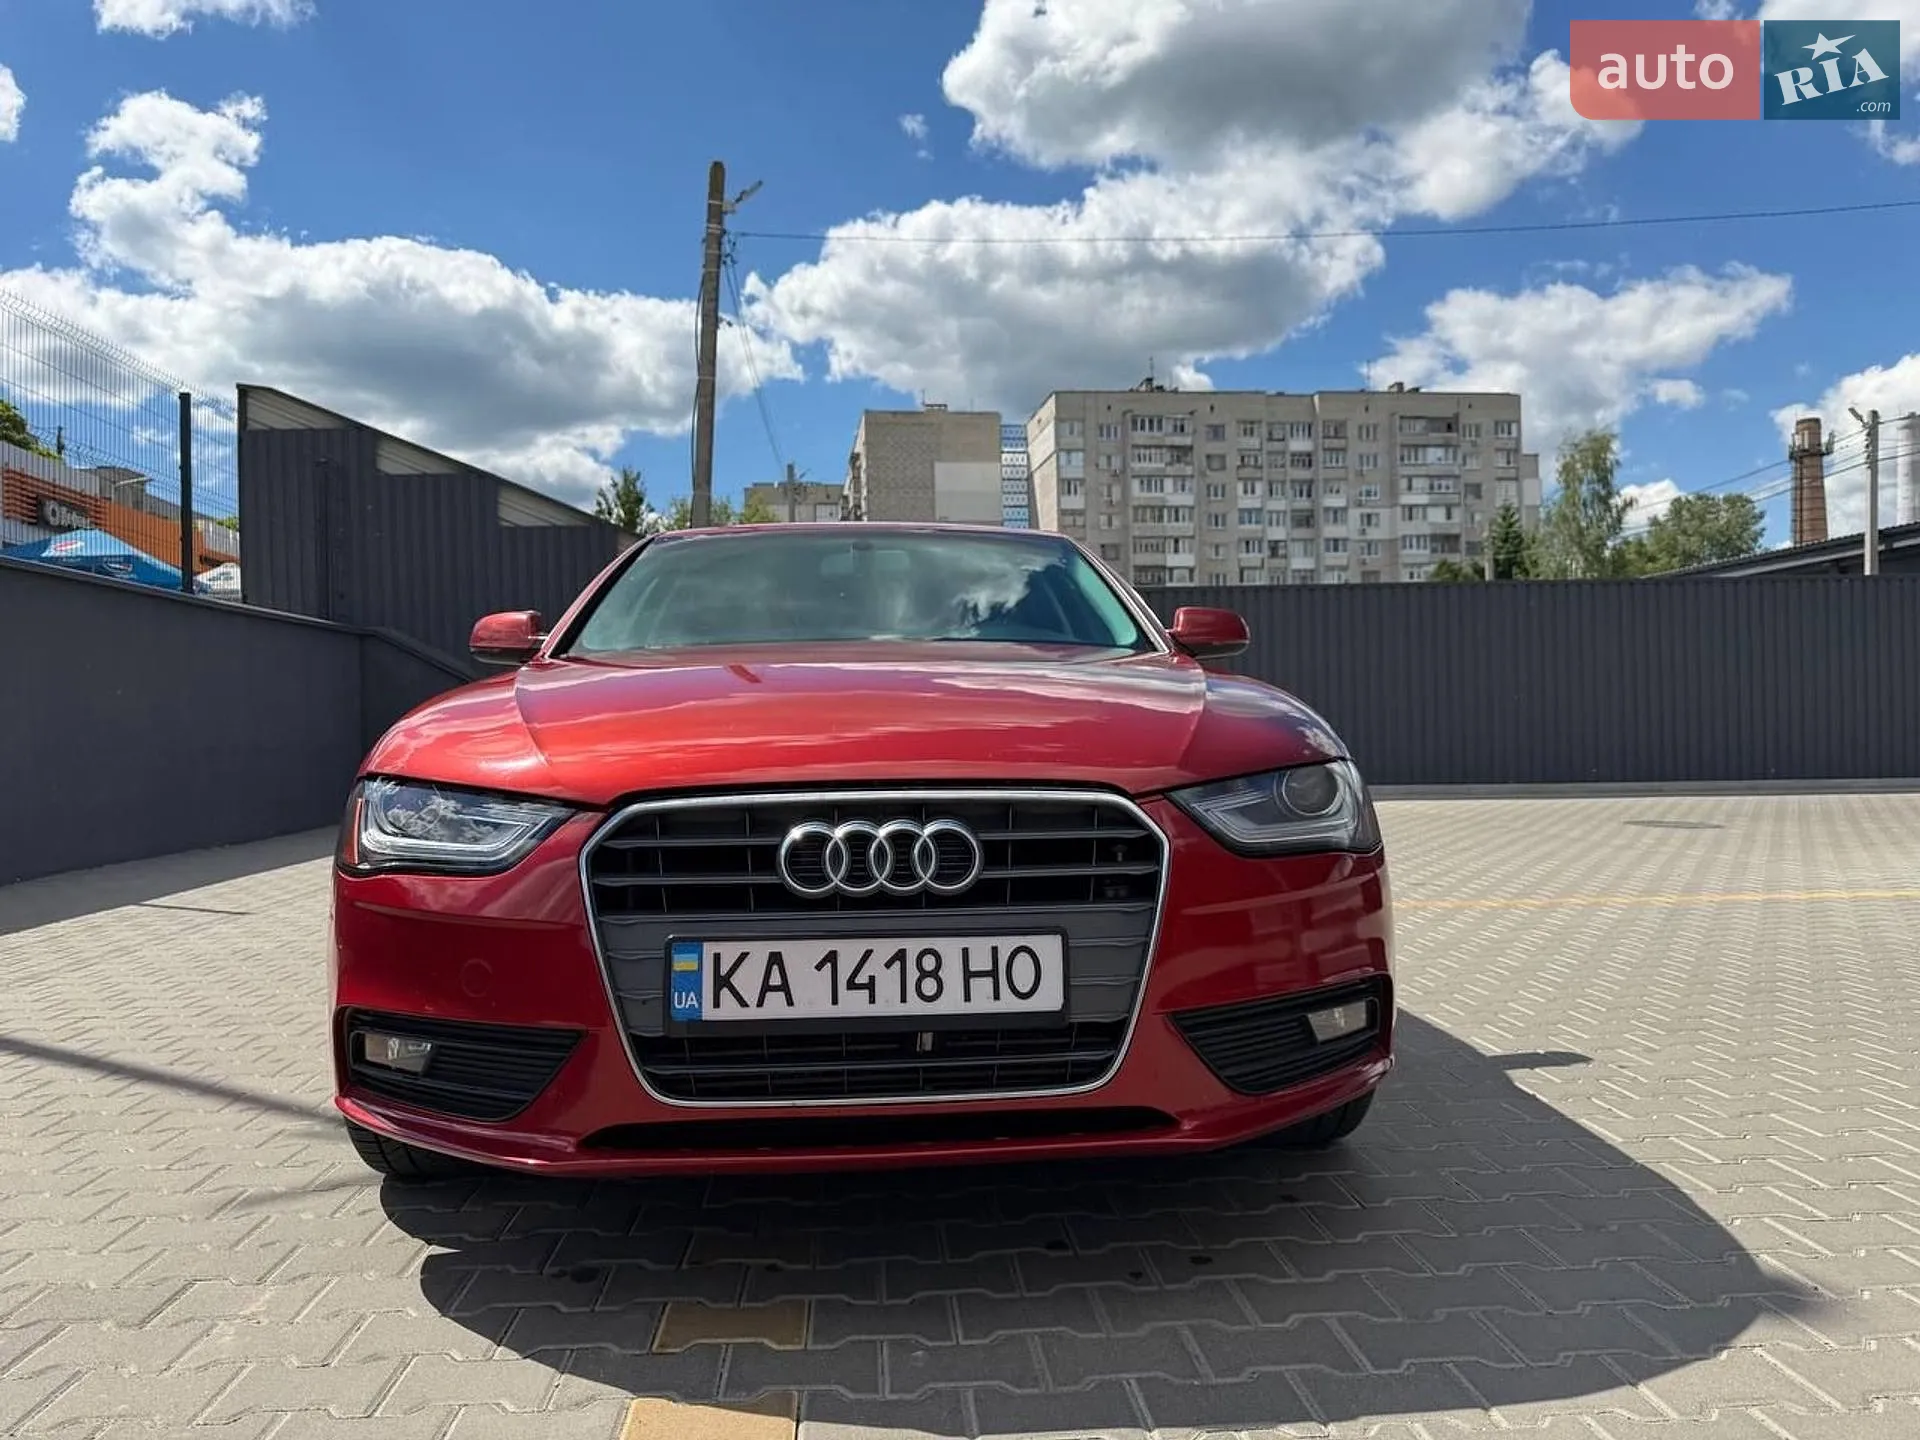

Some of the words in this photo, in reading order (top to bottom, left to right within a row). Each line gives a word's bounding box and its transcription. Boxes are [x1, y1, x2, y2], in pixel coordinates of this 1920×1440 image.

[713, 951, 794, 1009] KA
[814, 948, 944, 1006] 1418
[962, 945, 1042, 1003] HO
[674, 992, 698, 1008] UA
